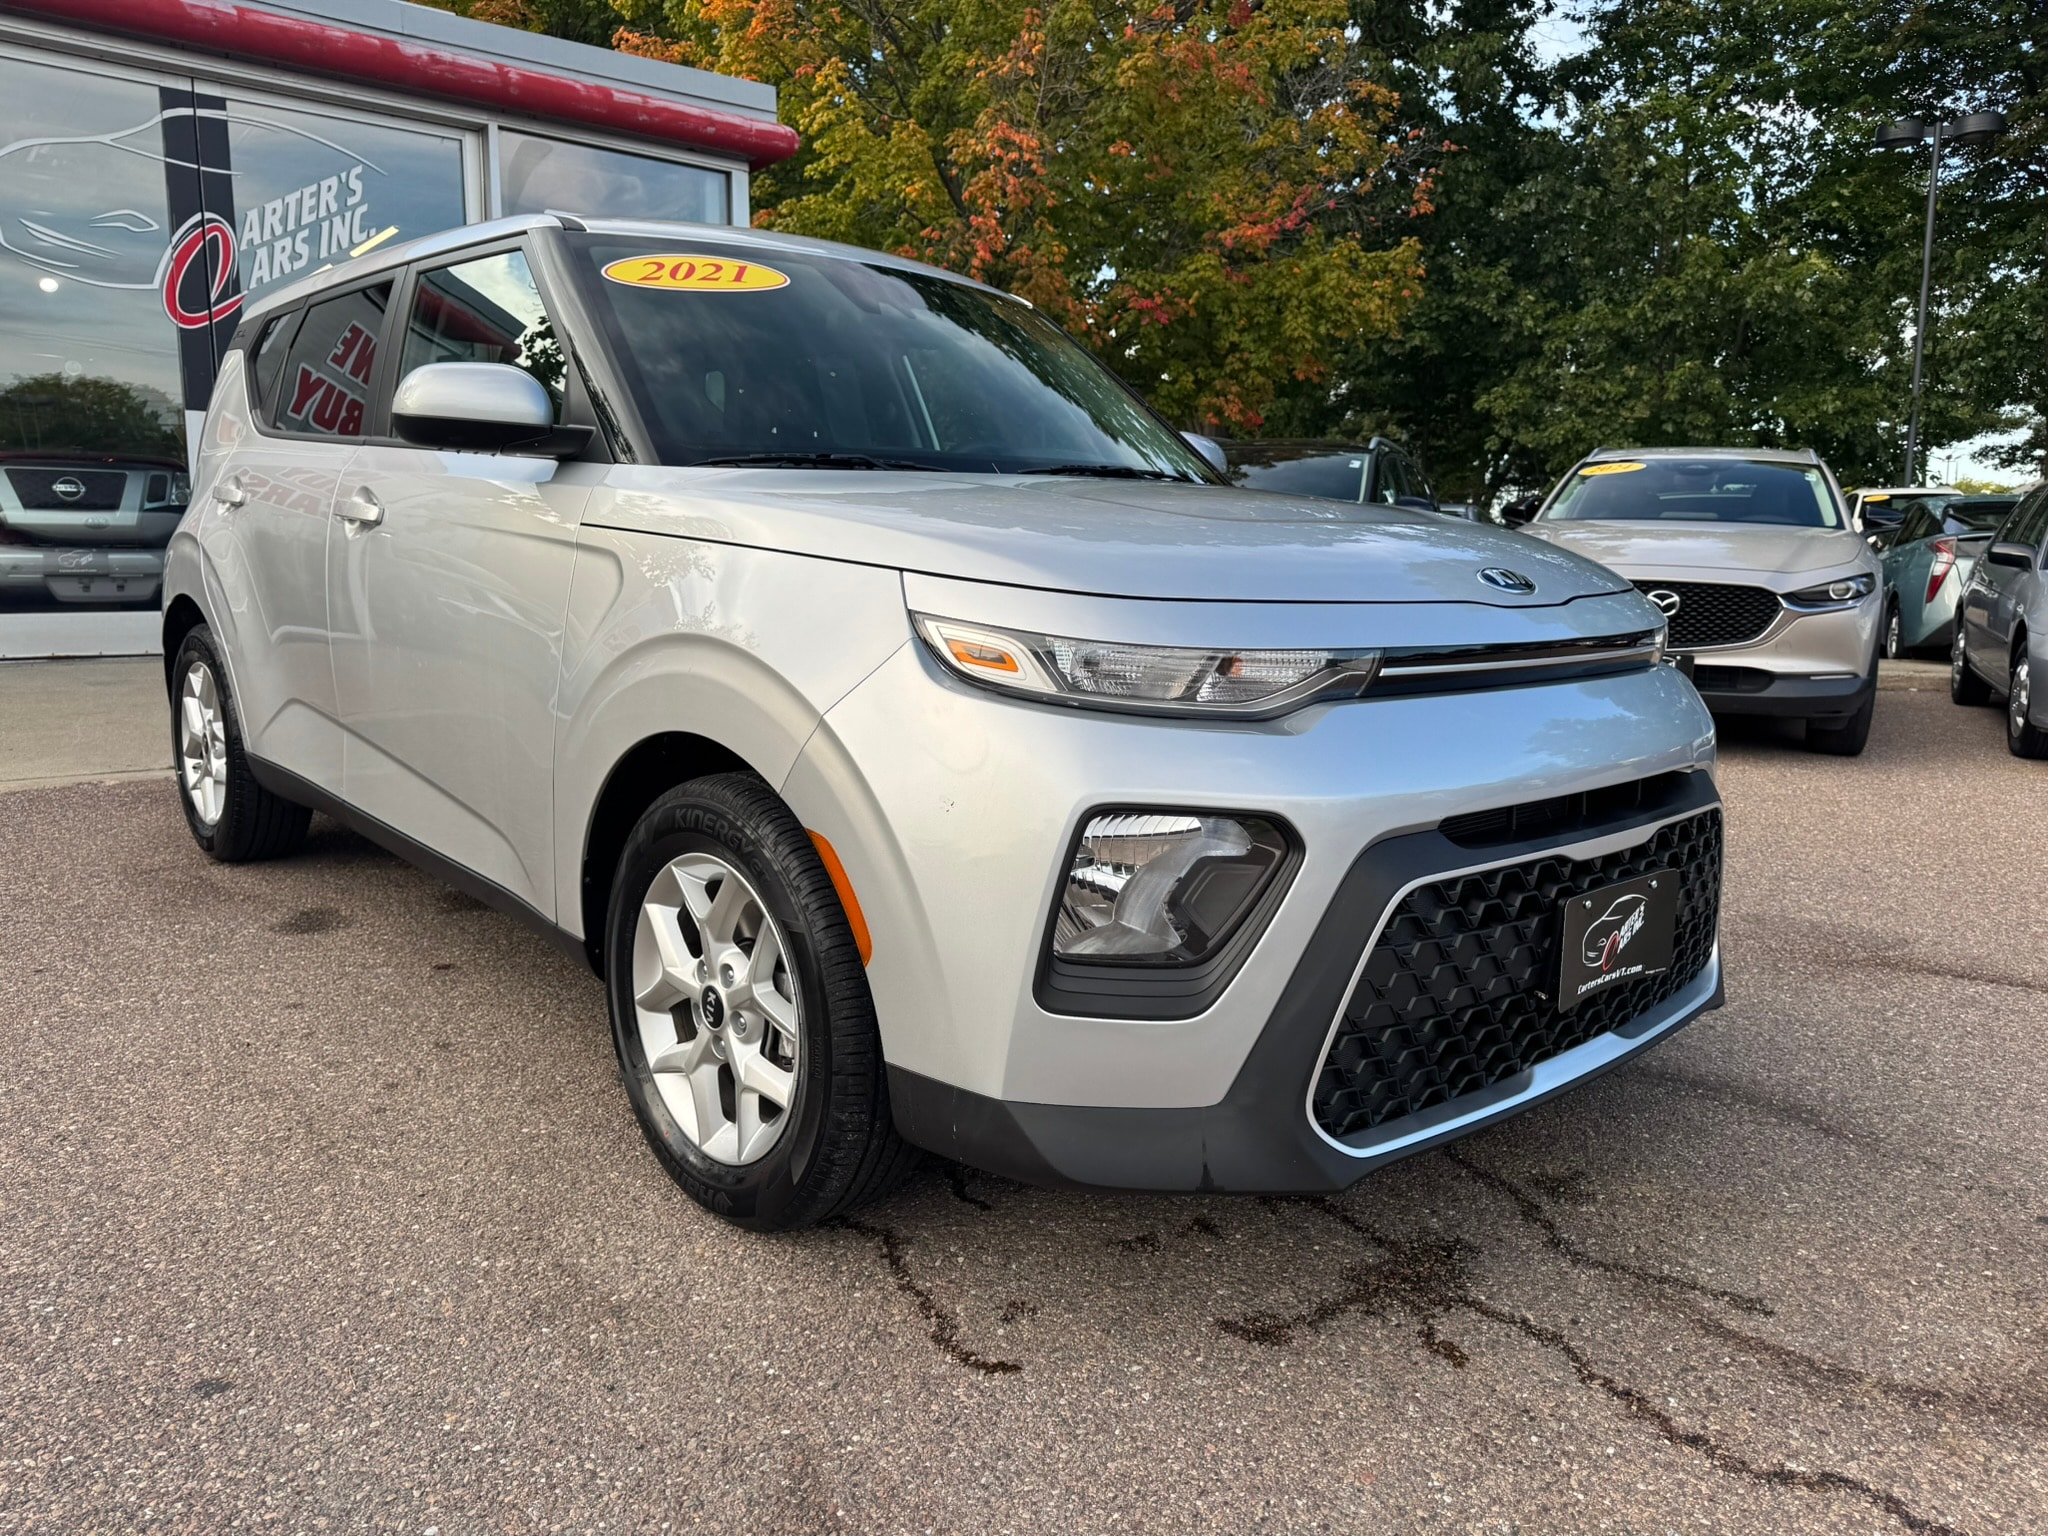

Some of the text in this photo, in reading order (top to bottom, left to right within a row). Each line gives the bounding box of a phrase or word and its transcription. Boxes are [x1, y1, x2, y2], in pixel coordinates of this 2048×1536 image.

[319, 203, 376, 260] INC.
[637, 261, 748, 284] 2021
[675, 807, 755, 855] KINERGY
[1577, 964, 1643, 995] CartersCarsVT.com
[706, 991, 717, 1023] KIA
